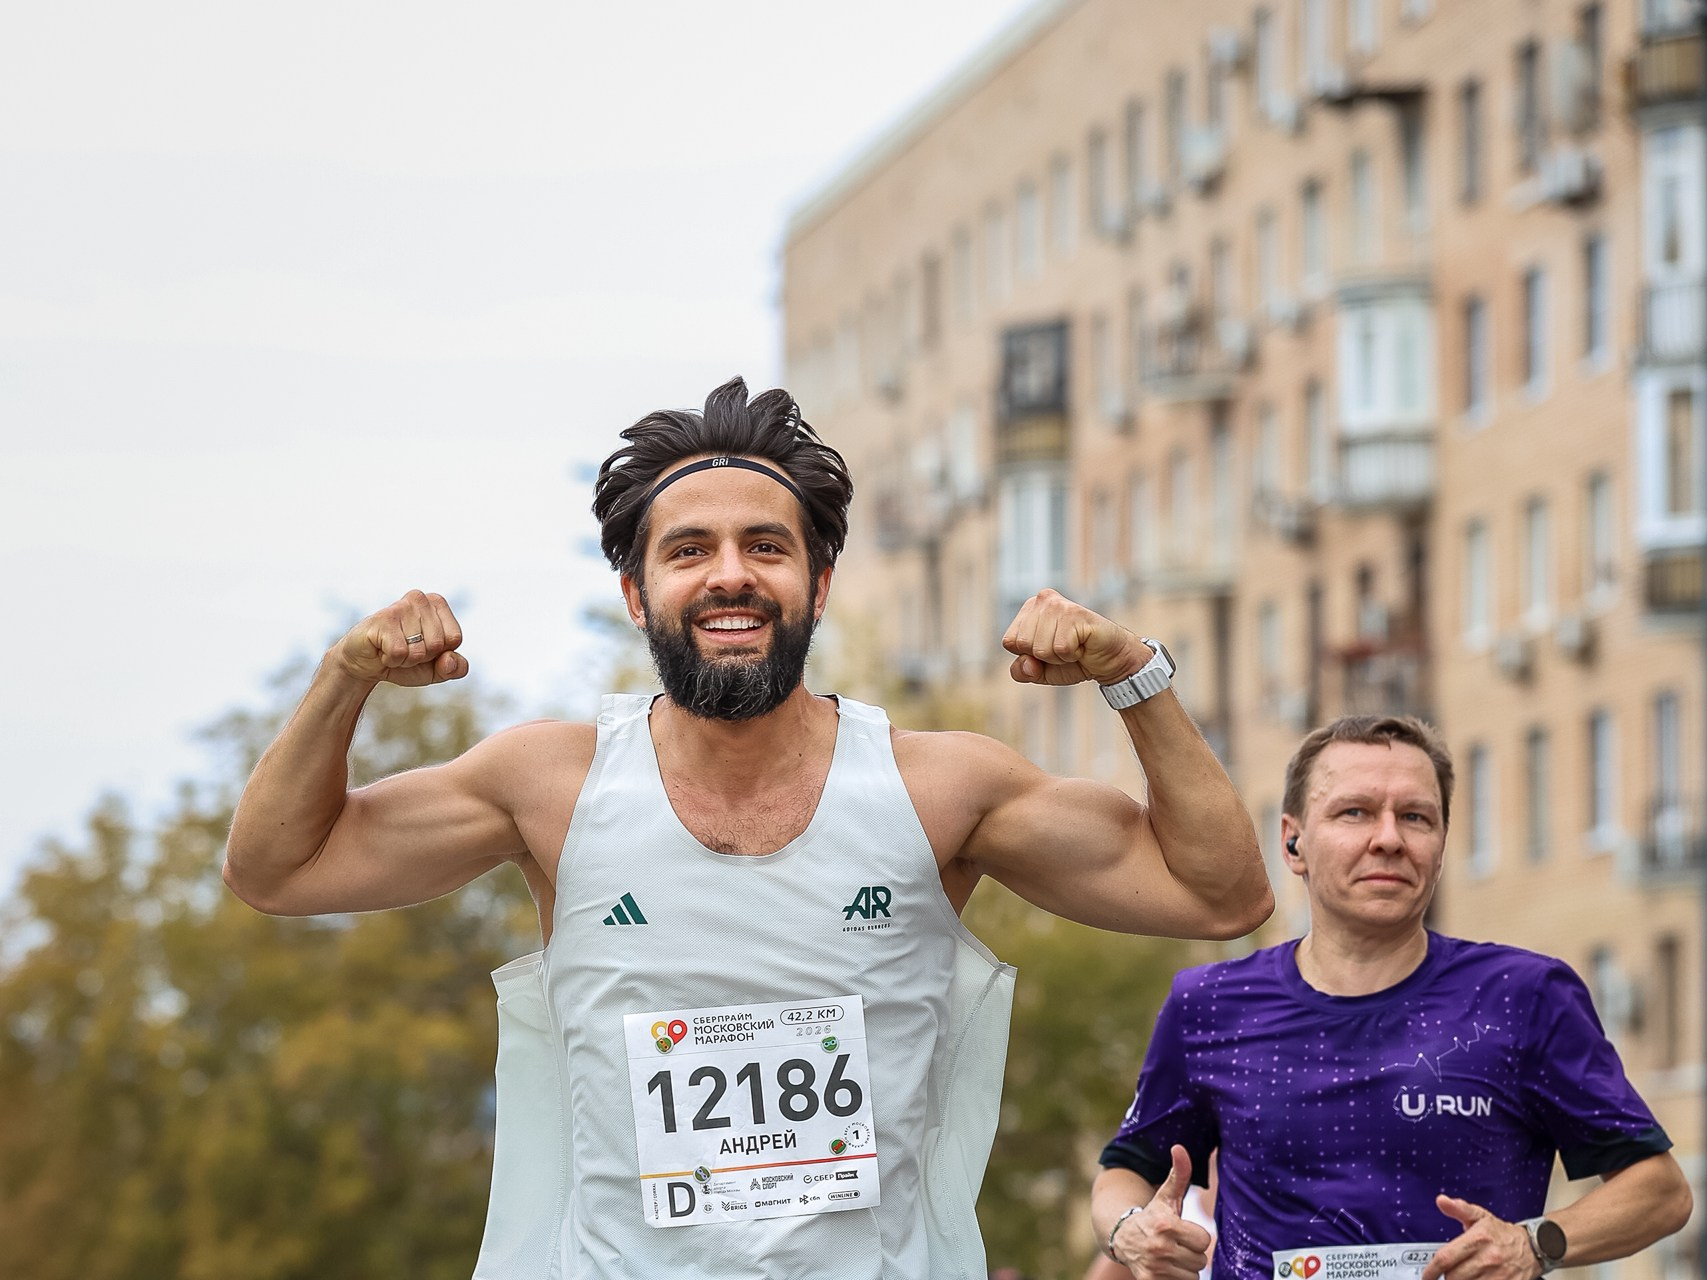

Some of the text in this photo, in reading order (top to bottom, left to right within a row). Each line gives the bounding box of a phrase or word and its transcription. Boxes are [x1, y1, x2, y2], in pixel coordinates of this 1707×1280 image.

[693, 1013, 753, 1025] СБЕРПРАЙМ
[787, 1011, 813, 1022] 42,2
[694, 1019, 775, 1035] МОСКОВСКИЙ
[796, 1025, 831, 1037] 2026
[695, 1032, 755, 1045] МАРАФОН
[648, 1053, 863, 1134] 12186
[1436, 1094, 1493, 1117] RUN
[852, 1129, 860, 1140] 1
[719, 1129, 798, 1156] АНДРЕЙ
[814, 1174, 835, 1182] СБЕР
[667, 1181, 696, 1218] D
[1326, 1252, 1378, 1261] СБЕРПРАЙМ
[1326, 1258, 1397, 1270] МОСКОВСКИЙ
[1326, 1269, 1379, 1279] МАРАФОН
